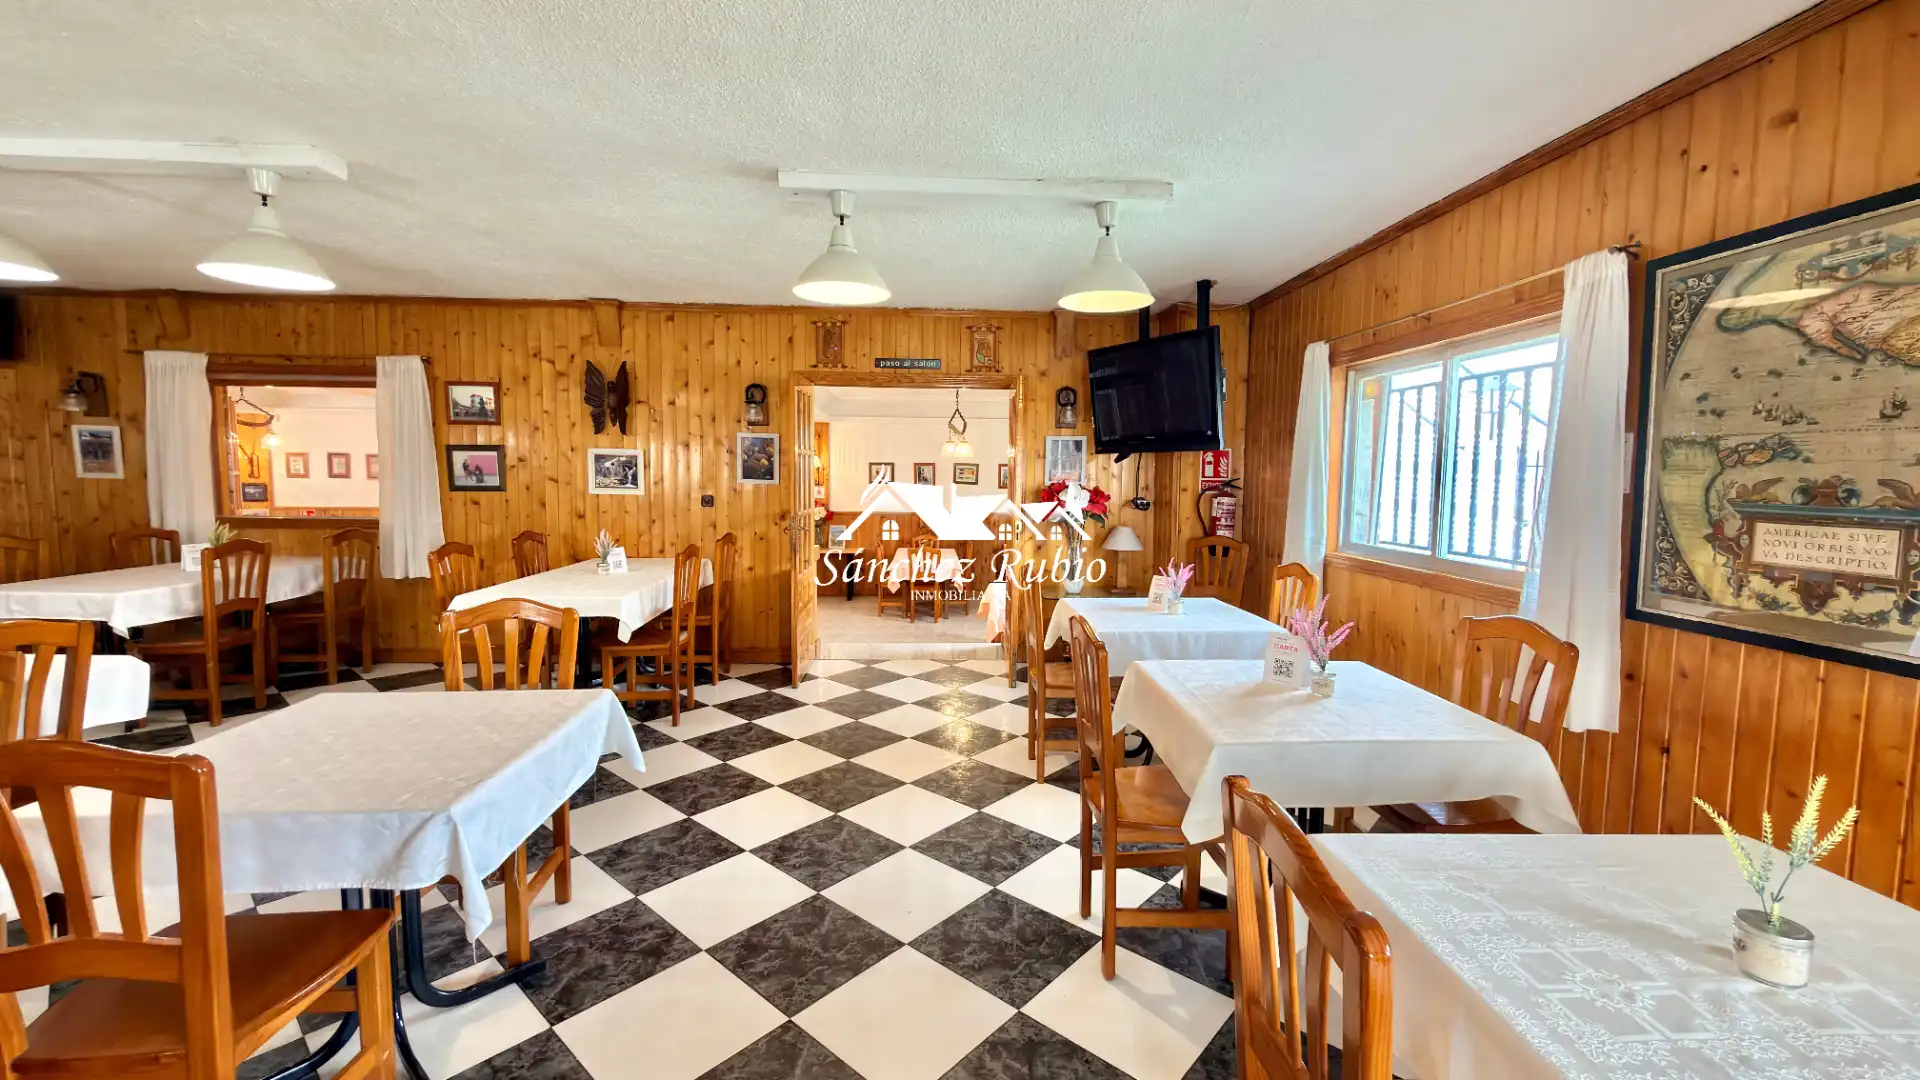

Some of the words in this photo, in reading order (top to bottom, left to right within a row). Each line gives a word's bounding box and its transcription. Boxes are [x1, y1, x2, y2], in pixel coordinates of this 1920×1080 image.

[880, 360, 900, 368] paso
[1763, 527, 1840, 540] AMERICAE
[1762, 539, 1798, 549] NOVI
[1762, 550, 1779, 559] VA
[1273, 643, 1299, 653] CARTA
